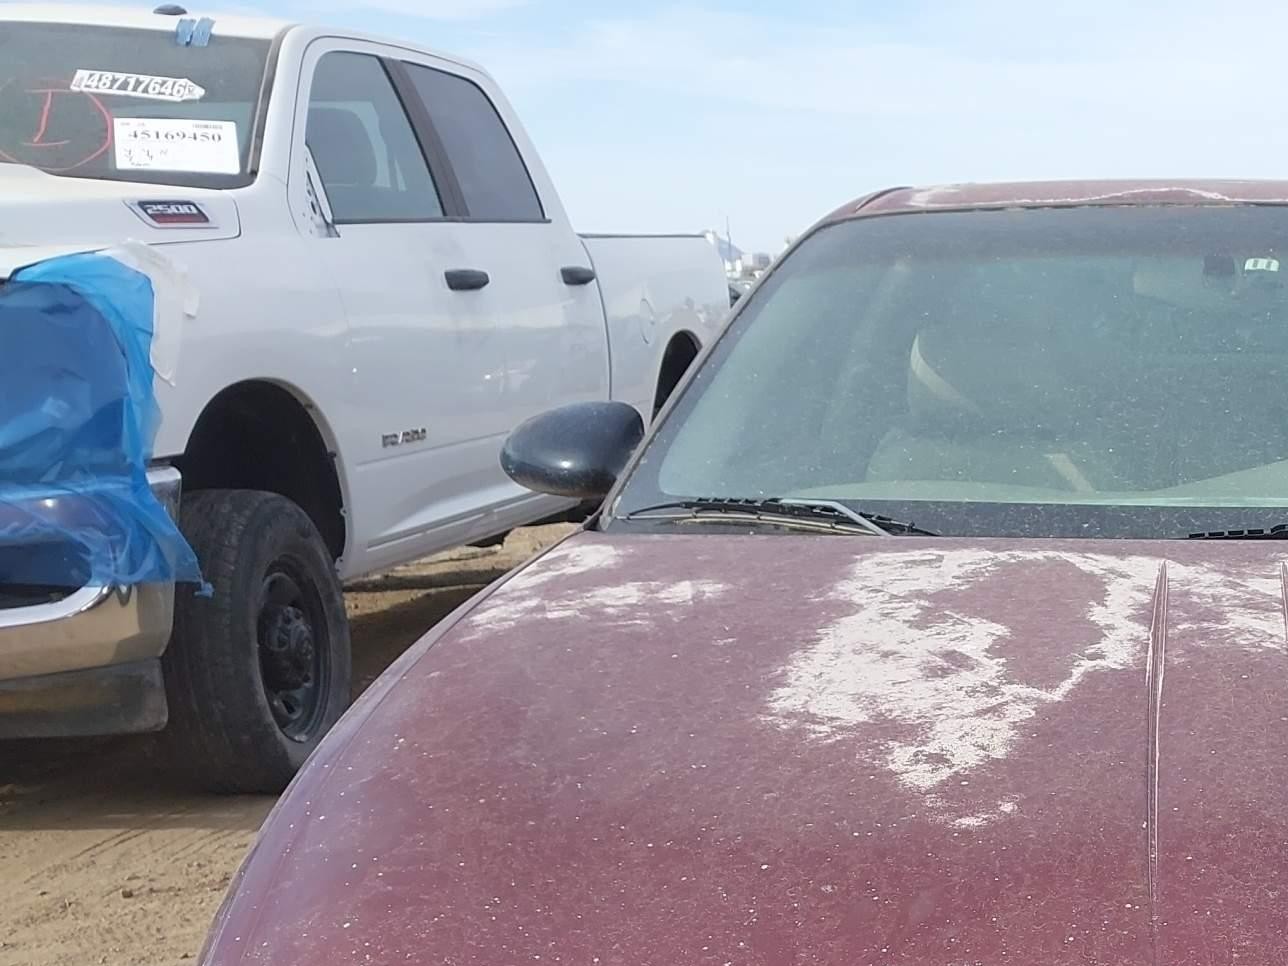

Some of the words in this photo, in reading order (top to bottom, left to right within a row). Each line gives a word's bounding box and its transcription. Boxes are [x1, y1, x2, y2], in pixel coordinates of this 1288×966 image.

[86, 72, 186, 98] 48717646
[128, 129, 222, 143] 45169450
[144, 204, 199, 215] 2500
